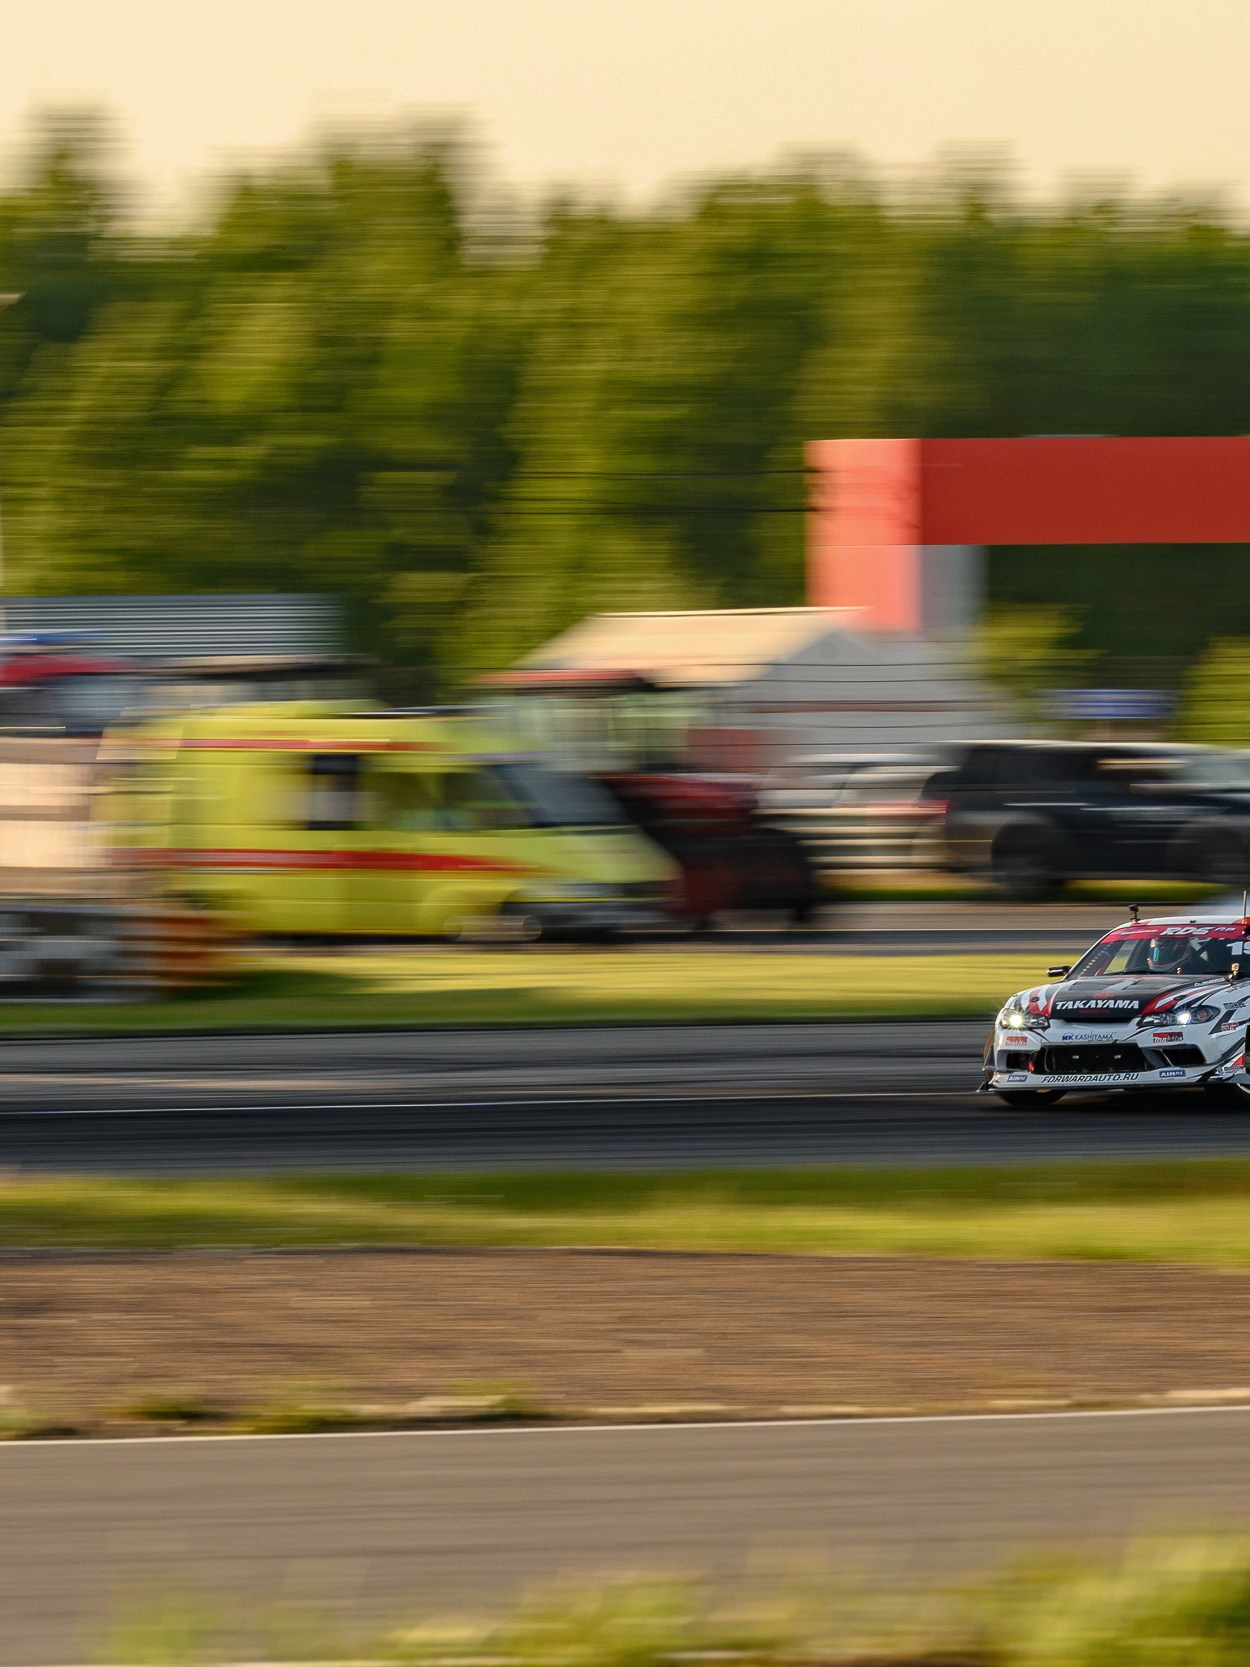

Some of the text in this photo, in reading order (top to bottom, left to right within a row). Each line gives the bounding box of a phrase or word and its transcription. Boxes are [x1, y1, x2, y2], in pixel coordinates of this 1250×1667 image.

[1160, 927, 1215, 936] RDS
[1055, 1000, 1140, 1010] TAKAYAMA
[1074, 1033, 1114, 1041] KASHIYAMA
[1041, 1072, 1141, 1084] FORWARDAUTO.RU
